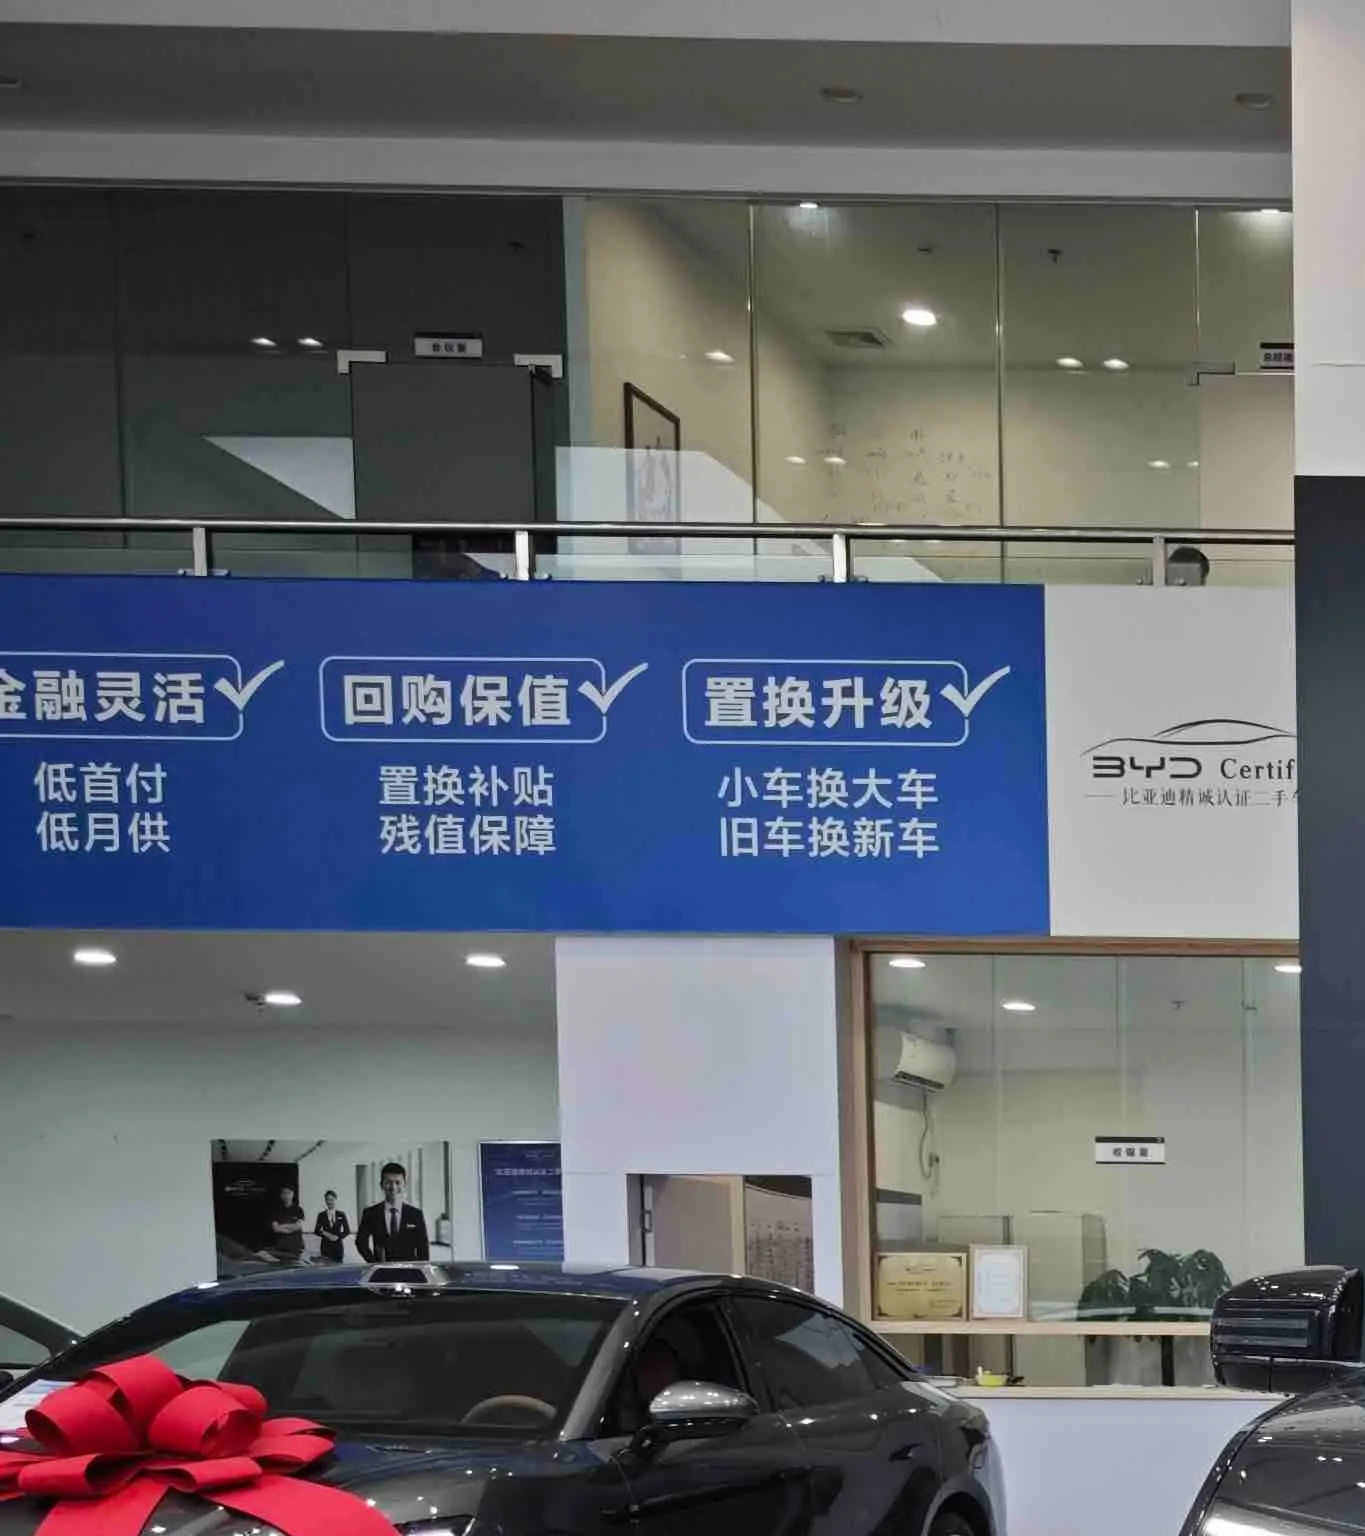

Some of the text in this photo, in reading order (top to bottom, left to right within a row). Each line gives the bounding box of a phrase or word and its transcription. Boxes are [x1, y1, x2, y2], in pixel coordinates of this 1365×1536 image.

[343, 674, 571, 727] 回购保值
[704, 676, 933, 729] 置换升级
[34, 761, 168, 804] 低首付
[378, 764, 555, 808] 置换补贴
[717, 766, 939, 810] 小车换大车
[1092, 755, 1202, 779] BYD
[1121, 786, 1299, 808] 比亚迪精诚认证二手
[36, 811, 171, 854] 低月供
[378, 813, 557, 856] 残值保障
[719, 815, 940, 859] 旧车换新车
